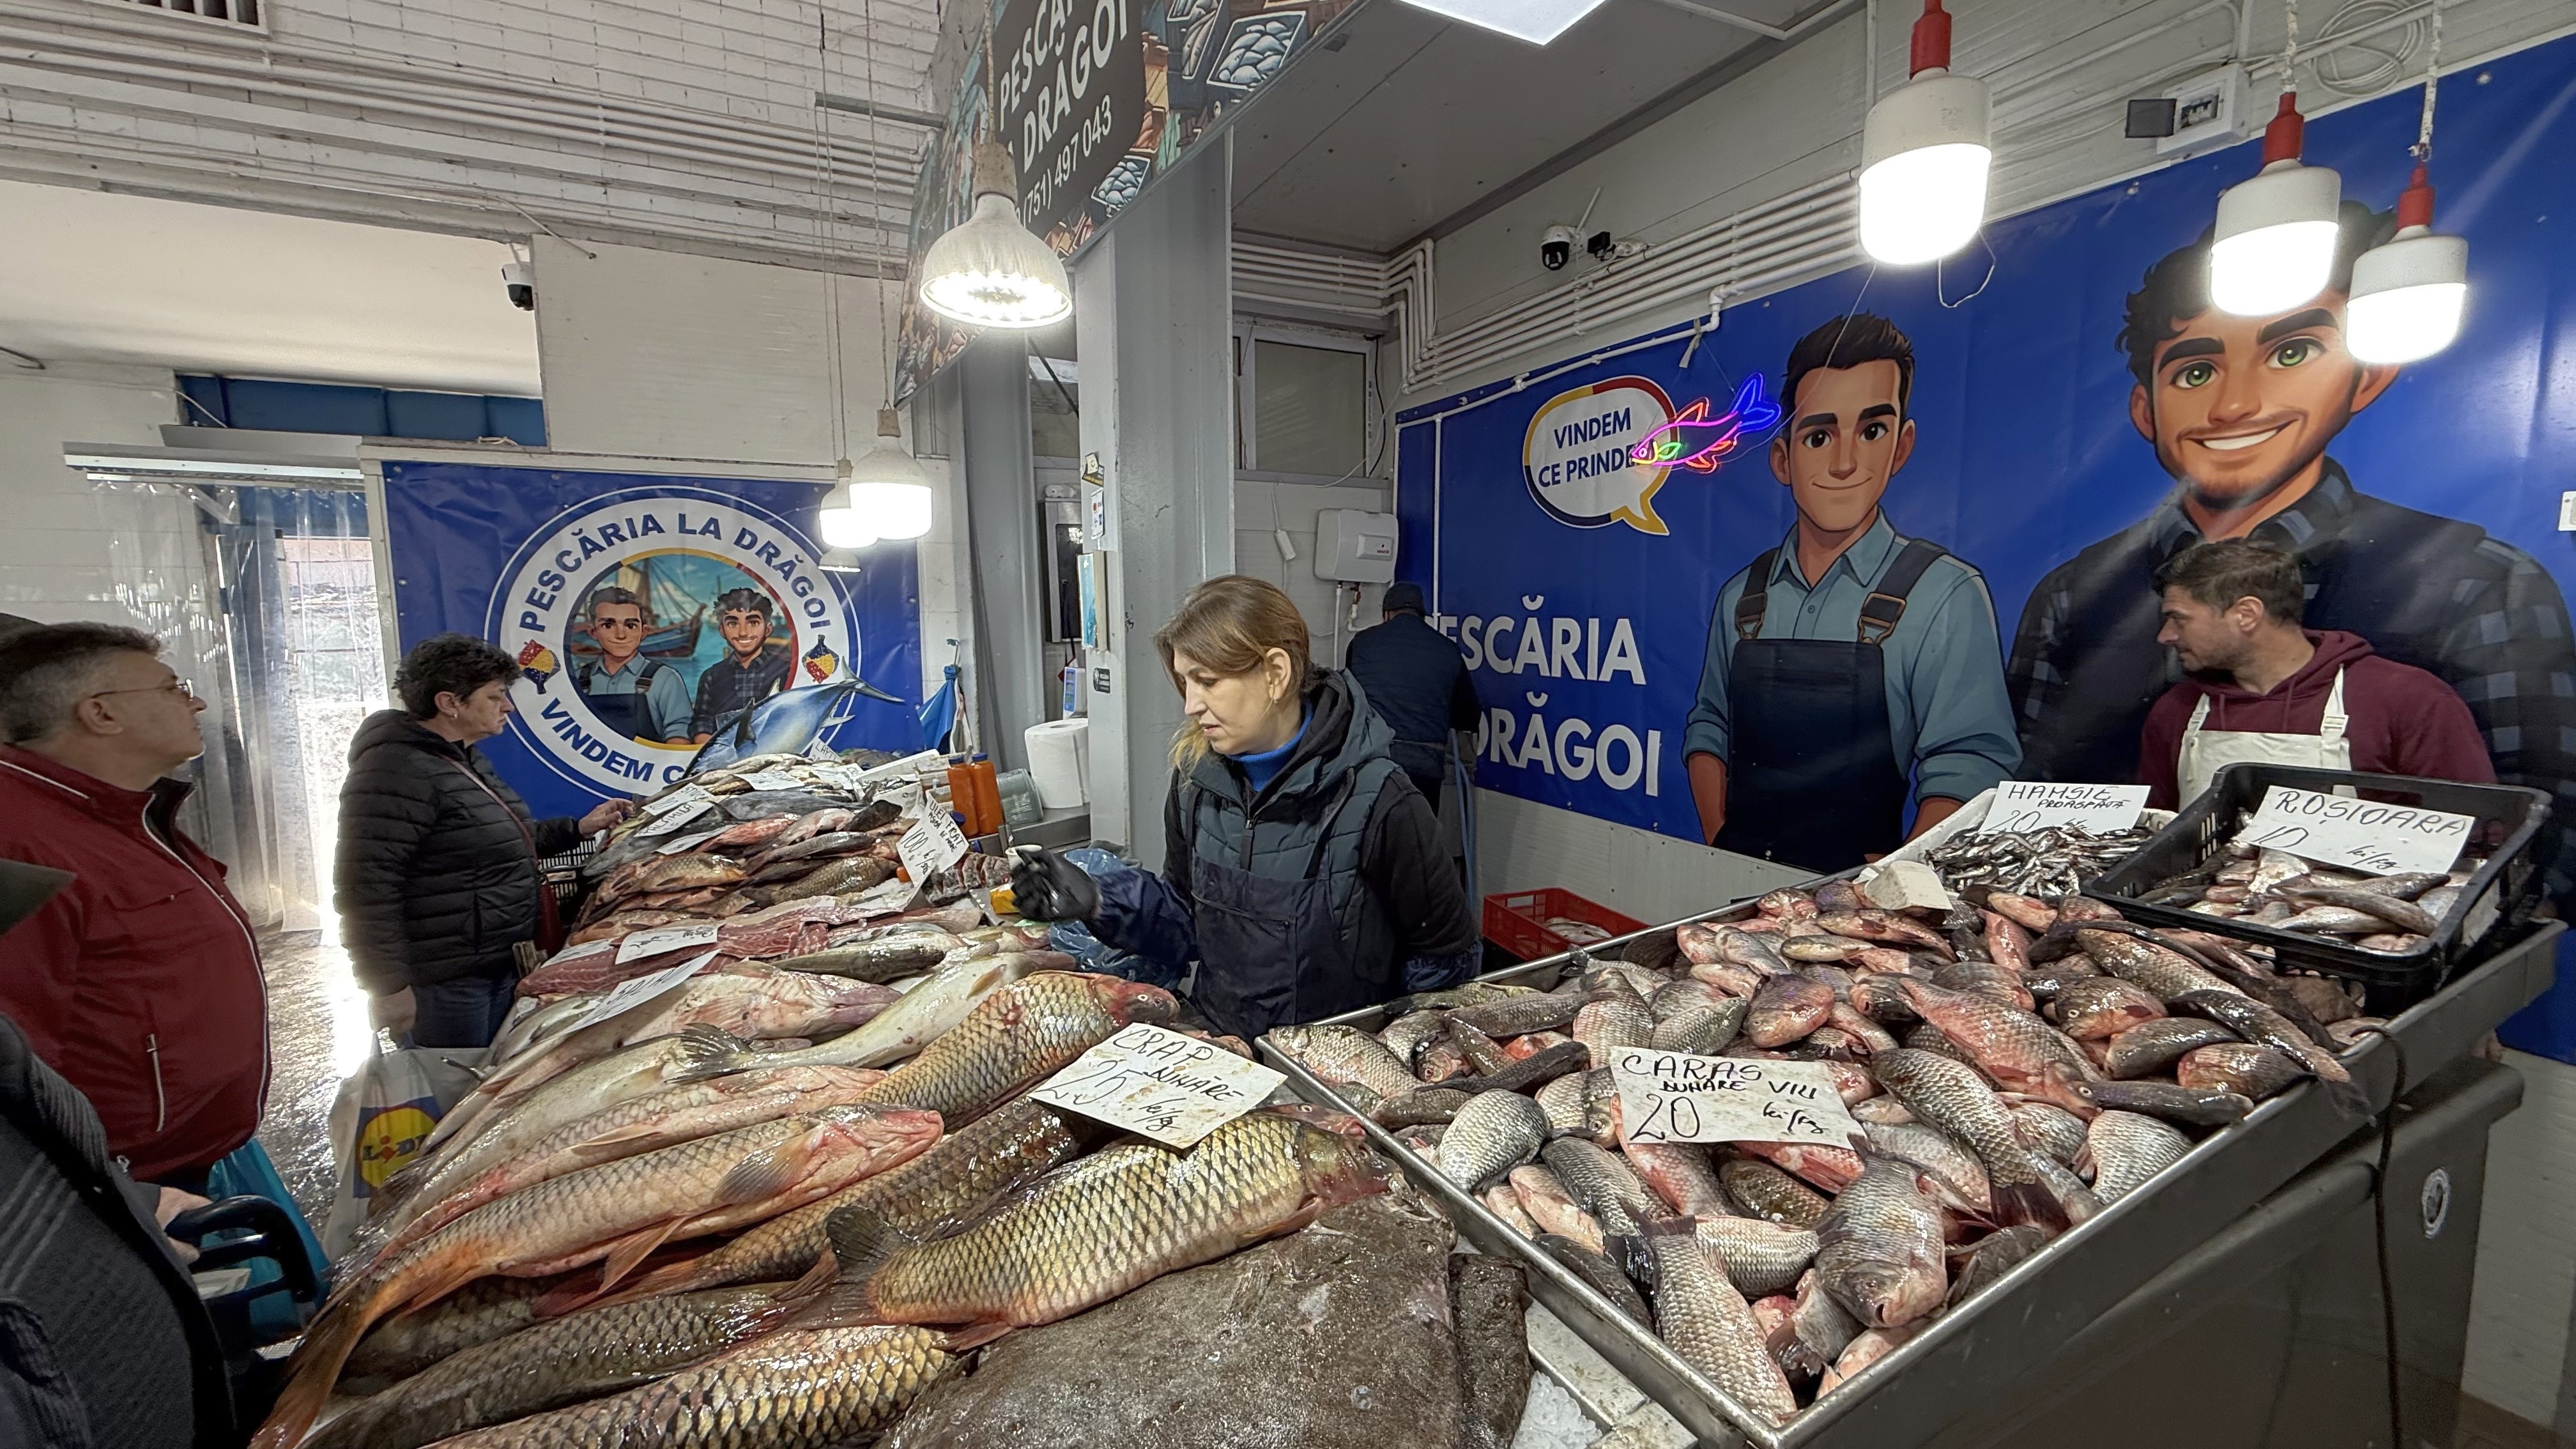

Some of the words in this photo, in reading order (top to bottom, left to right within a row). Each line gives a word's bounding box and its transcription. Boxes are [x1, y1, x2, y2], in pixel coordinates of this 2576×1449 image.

[1055, 133, 1079, 187] 497
[1083, 95, 1112, 157] 043
[1554, 407, 1631, 448] VINDEM
[1538, 463, 1561, 487] CE
[1567, 440, 1654, 482] PRINDE
[519, 514, 665, 632] PESCĂRIA
[678, 513, 721, 540] LA
[733, 528, 831, 629] DRĂGOI
[1425, 595, 1646, 685] ESCĂRIA
[541, 698, 654, 782] VINDEM
[2007, 784, 2119, 800] HAMSIE
[1985, 809, 2041, 832] 20
[1112, 1028, 1213, 1066] CRAP
[1630, 1093, 1701, 1141] 20
